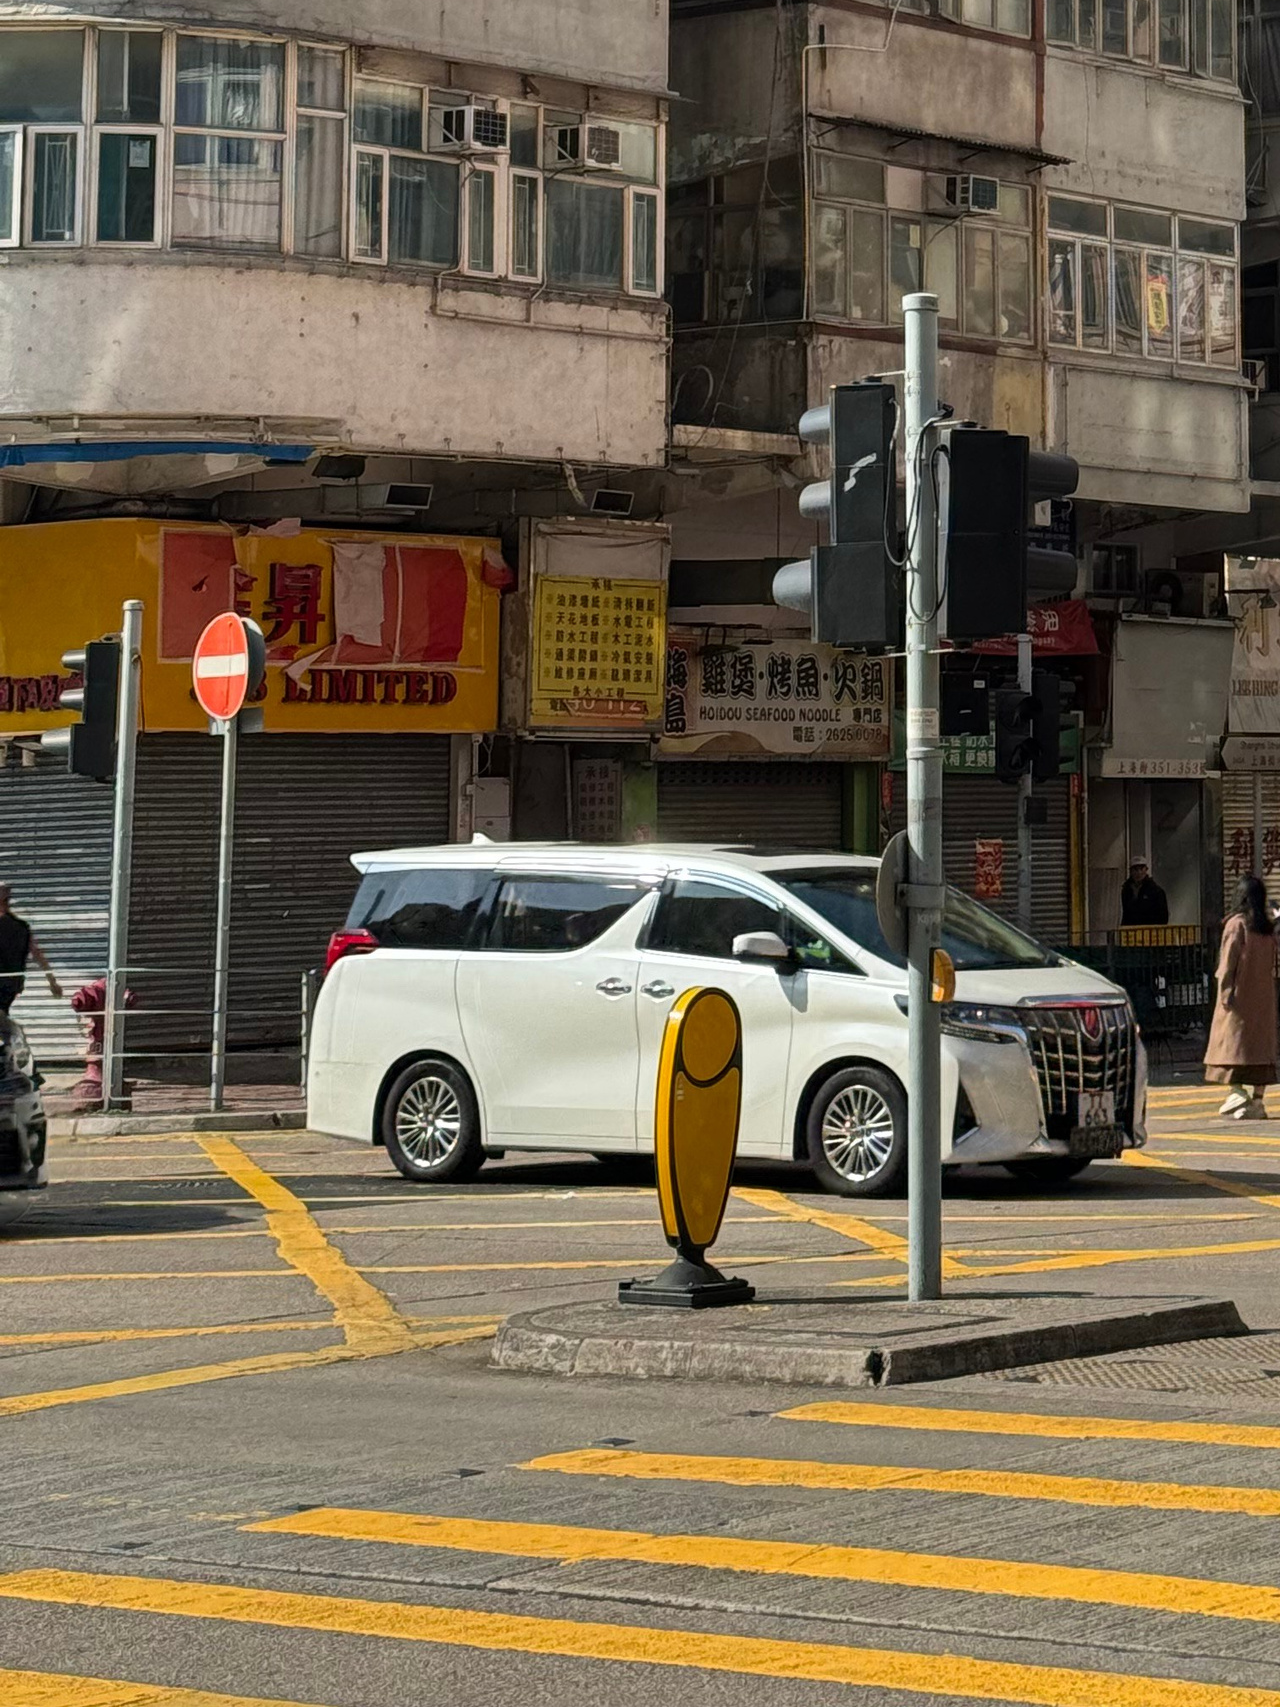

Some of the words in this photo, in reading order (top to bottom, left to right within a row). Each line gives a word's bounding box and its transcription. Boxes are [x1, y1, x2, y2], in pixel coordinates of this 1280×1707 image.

[282, 670, 458, 705] LIMITED
[700, 707, 742, 721] HOIDOU
[745, 707, 796, 722] SEAFOOD
[800, 707, 841, 722] NOODLE
